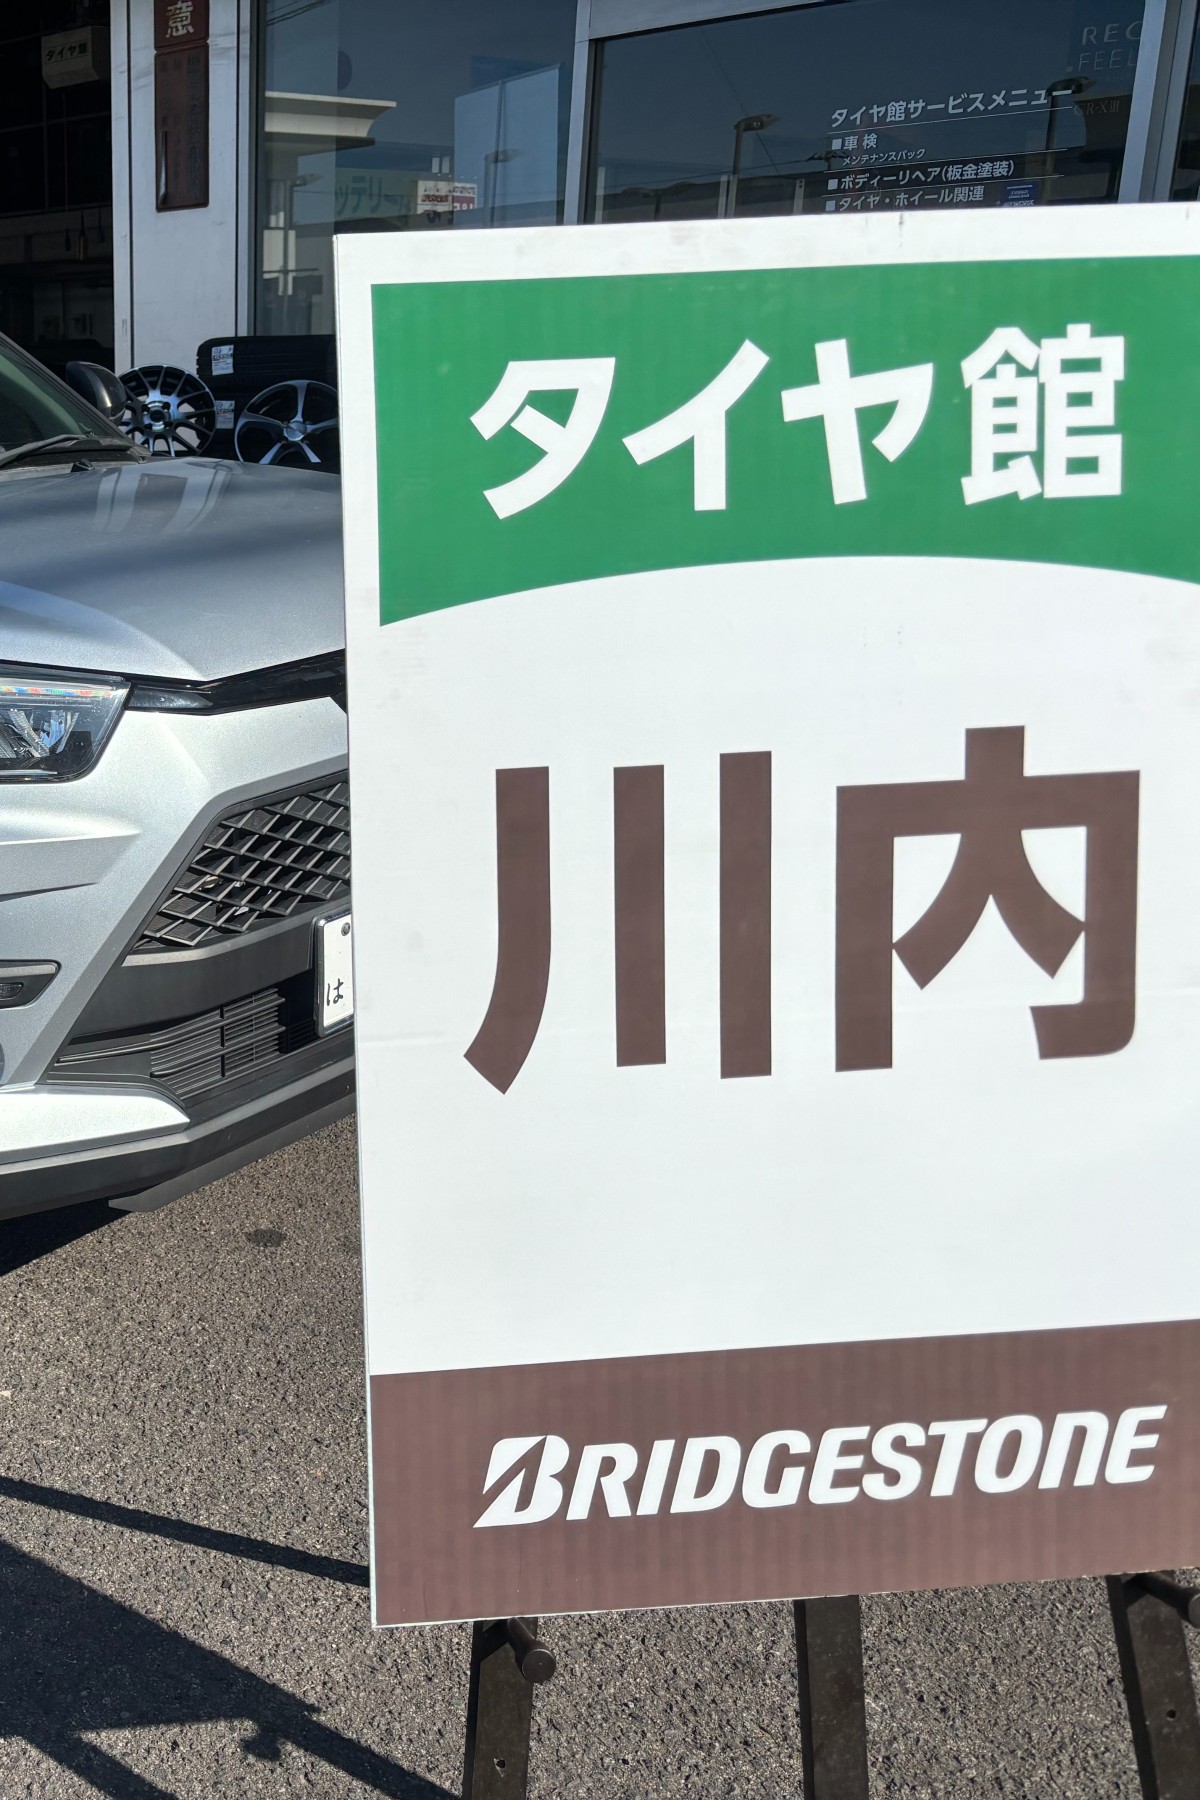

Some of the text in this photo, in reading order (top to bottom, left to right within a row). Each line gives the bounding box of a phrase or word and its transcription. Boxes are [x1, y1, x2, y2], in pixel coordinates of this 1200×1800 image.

[831, 89, 1072, 128] タイヤ館サービスメニュー
[469, 322, 1126, 520] タイヤ館
[463, 725, 1141, 1096] 川内
[326, 978, 344, 1007] は
[472, 1404, 1168, 1529] BRIDGESTONE
